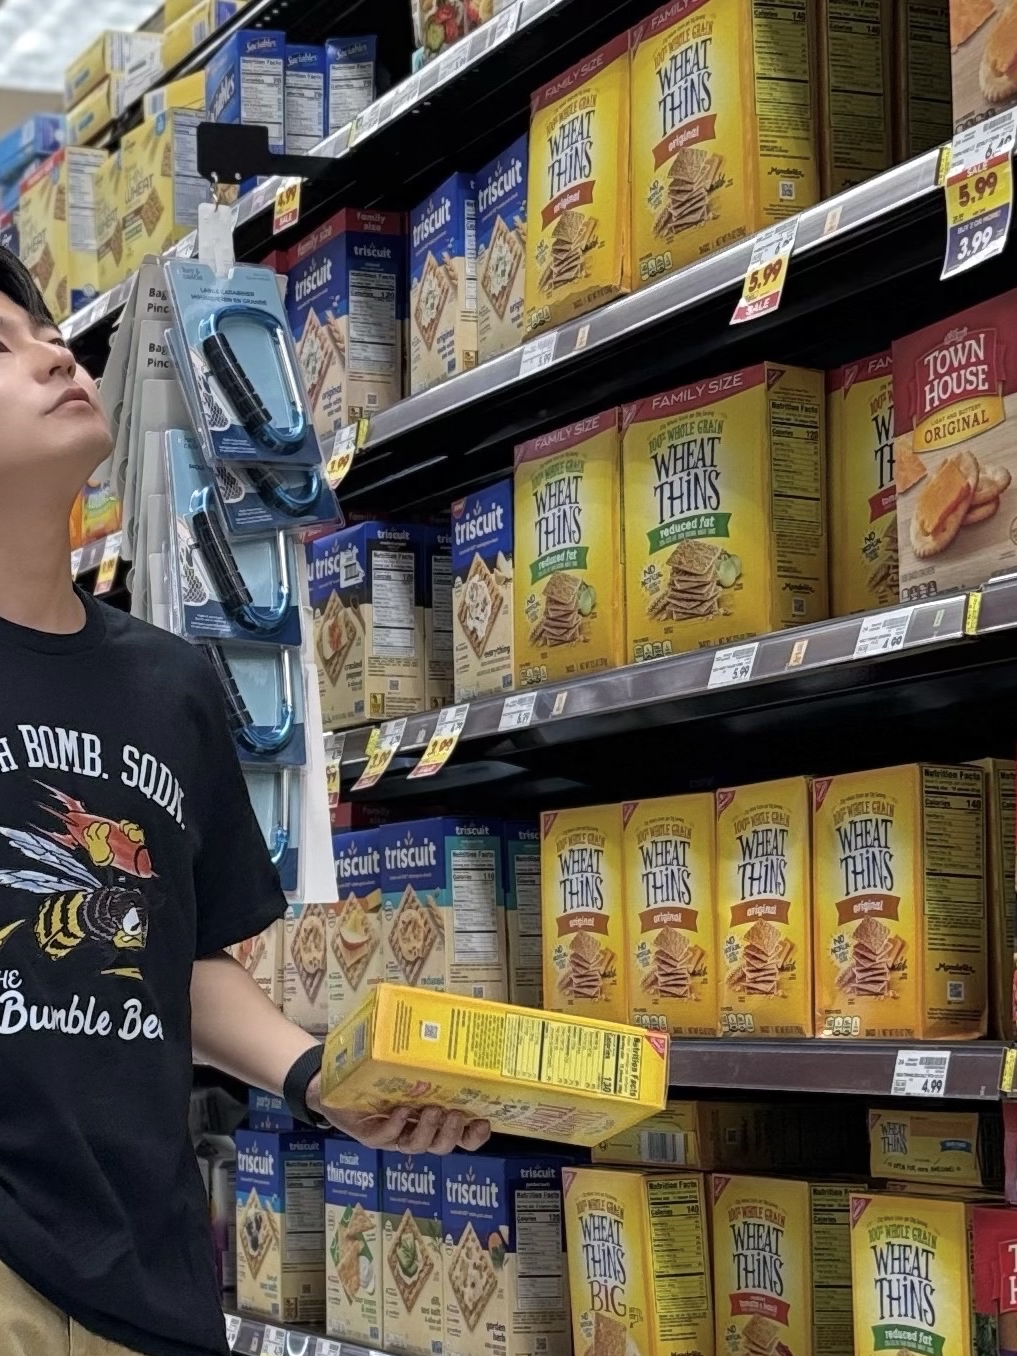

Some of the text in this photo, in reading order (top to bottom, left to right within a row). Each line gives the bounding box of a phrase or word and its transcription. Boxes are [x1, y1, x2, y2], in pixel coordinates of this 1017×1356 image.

[545, 54, 604, 100] FAMILY SIZE
[656, 37, 712, 96] WHEAT
[547, 110, 595, 161] WHEAT
[668, 125, 699, 151] original
[478, 158, 522, 213] triscuit
[966, 161, 989, 178] SALE
[958, 172, 998, 207] 5.99
[413, 197, 450, 248] triscuit
[353, 245, 391, 258] triscuit
[957, 226, 993, 260] 3.99
[295, 258, 332, 302] triscuit
[748, 258, 782, 292] 5.99
[745, 297, 770, 315] SALE
[924, 333, 985, 381] TOWN
[652, 383, 705, 411] FAMILY
[708, 372, 743, 394] SIZE
[924, 365, 989, 413] HOUSE
[535, 416, 600, 450] FAMILY SIZE
[667, 418, 724, 441] WHOLE GRAIN
[924, 410, 989, 444] ORIGINAL
[650, 436, 721, 482] WHEAT
[532, 476, 583, 517] WHEAT
[377, 529, 409, 541] triscuit
[455, 503, 503, 546] triscuit
[660, 515, 714, 539] reduced fat
[538, 549, 577, 570] reduced fat
[17, 724, 109, 780] BOMB.
[848, 801, 895, 818] WHOLE GRAIN
[455, 823, 489, 836] triscuit
[736, 828, 789, 862] WHEAT
[836, 818, 893, 856] WHEAT
[385, 840, 437, 870] triscuit
[557, 848, 603, 877] WHEAT
[639, 840, 691, 871] WHEAT
[569, 917, 595, 928] original
[653, 911, 682, 924] original
[746, 904, 777, 917] original
[853, 900, 884, 914] original
[630, 1037, 641, 1097] Nutrition Facts
[603, 1077, 612, 1093] 130
[922, 1079, 942, 1094] 4.99
[880, 1122, 907, 1136] WHEAT
[289, 1142, 320, 1151] triscuit
[238, 1150, 274, 1176] triscuit
[386, 1163, 435, 1195] triscuit
[520, 1166, 556, 1179] triscuit
[446, 1174, 499, 1208] triscuit
[579, 1213, 623, 1247] WHEAT
[730, 1221, 784, 1257] WHEAT
[884, 1223, 937, 1250] WHOLE GRAIN
[870, 1241, 935, 1282] WHEAT
[884, 1328, 933, 1345] reduced fat
